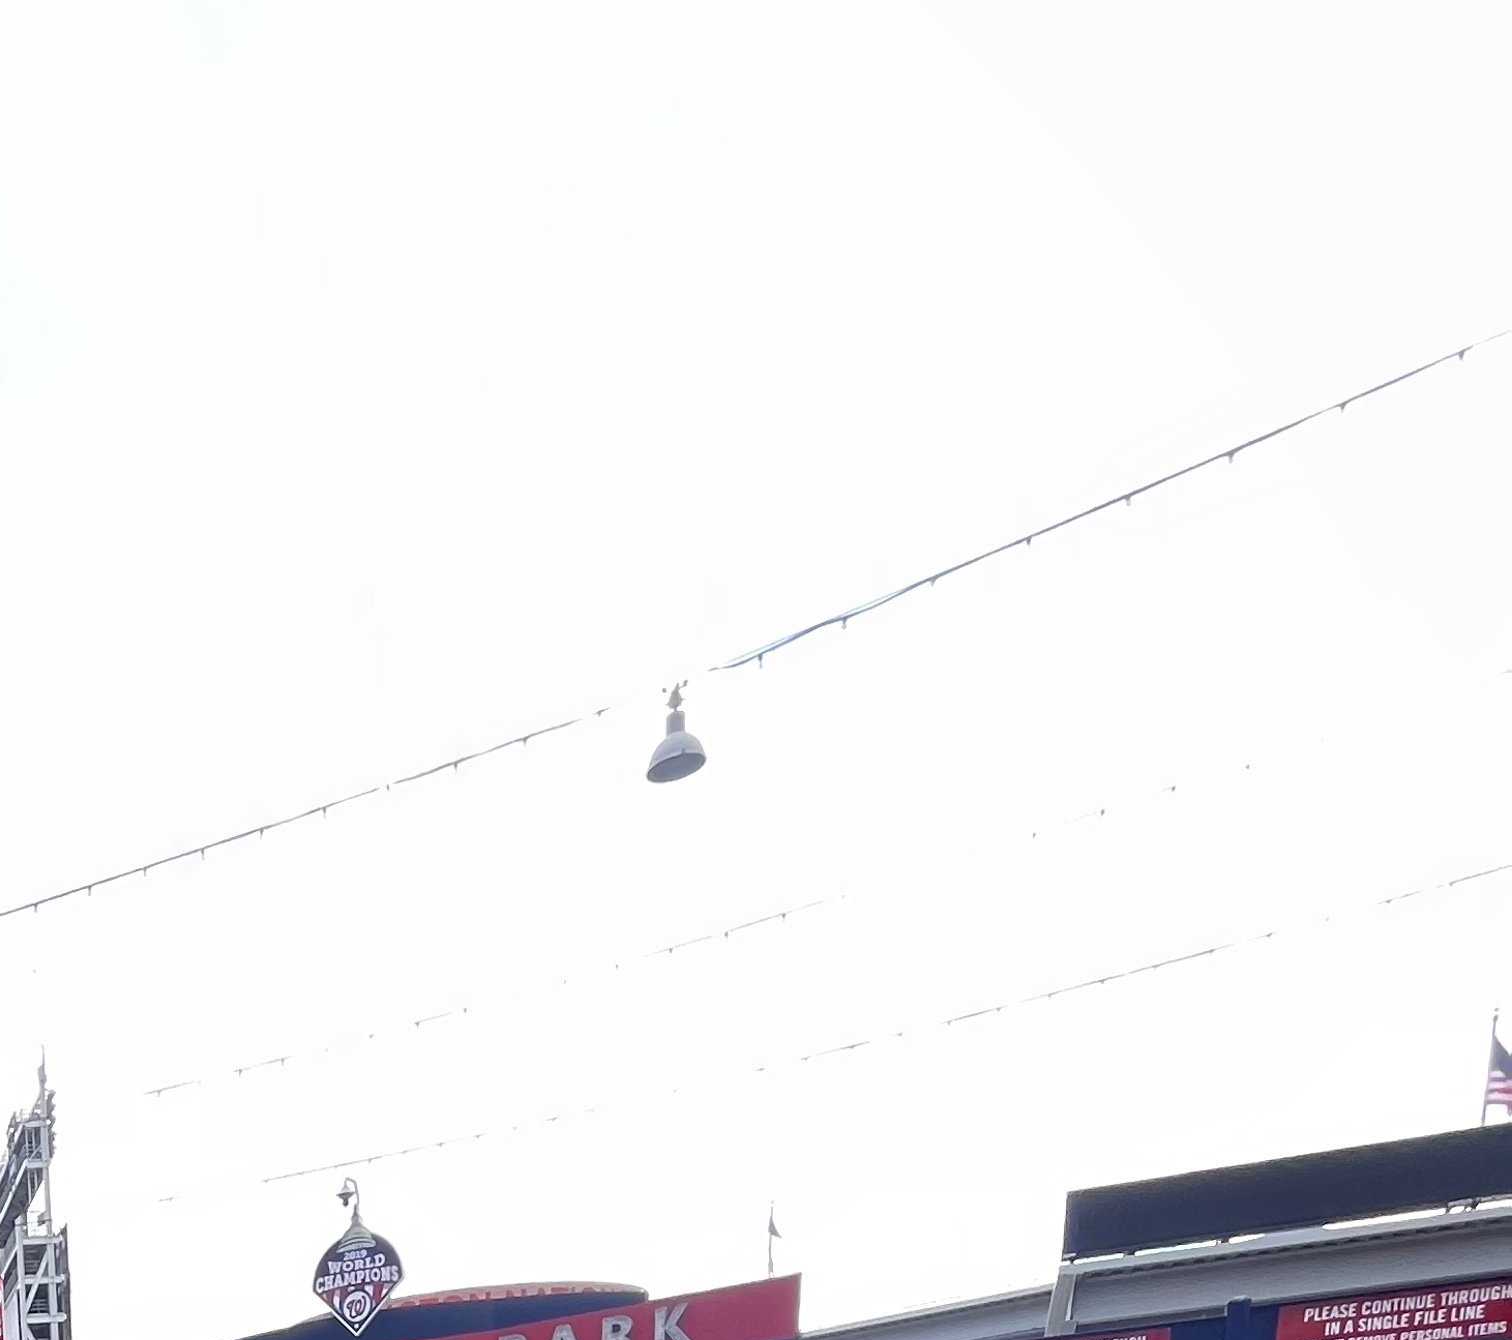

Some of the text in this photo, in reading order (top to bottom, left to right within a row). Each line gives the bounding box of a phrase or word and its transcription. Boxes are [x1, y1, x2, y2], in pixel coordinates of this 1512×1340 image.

[328, 1253, 385, 1274] WORLD
[343, 1249, 367, 1261] 2019
[315, 1265, 399, 1294] CHAMPIONS
[1303, 1285, 1512, 1322] PLEASE CONTINUE THROUGH
[1324, 1305, 1486, 1336] IN A SINGLE FILE LINE
[1468, 1321, 1507, 1336] ITEMS
